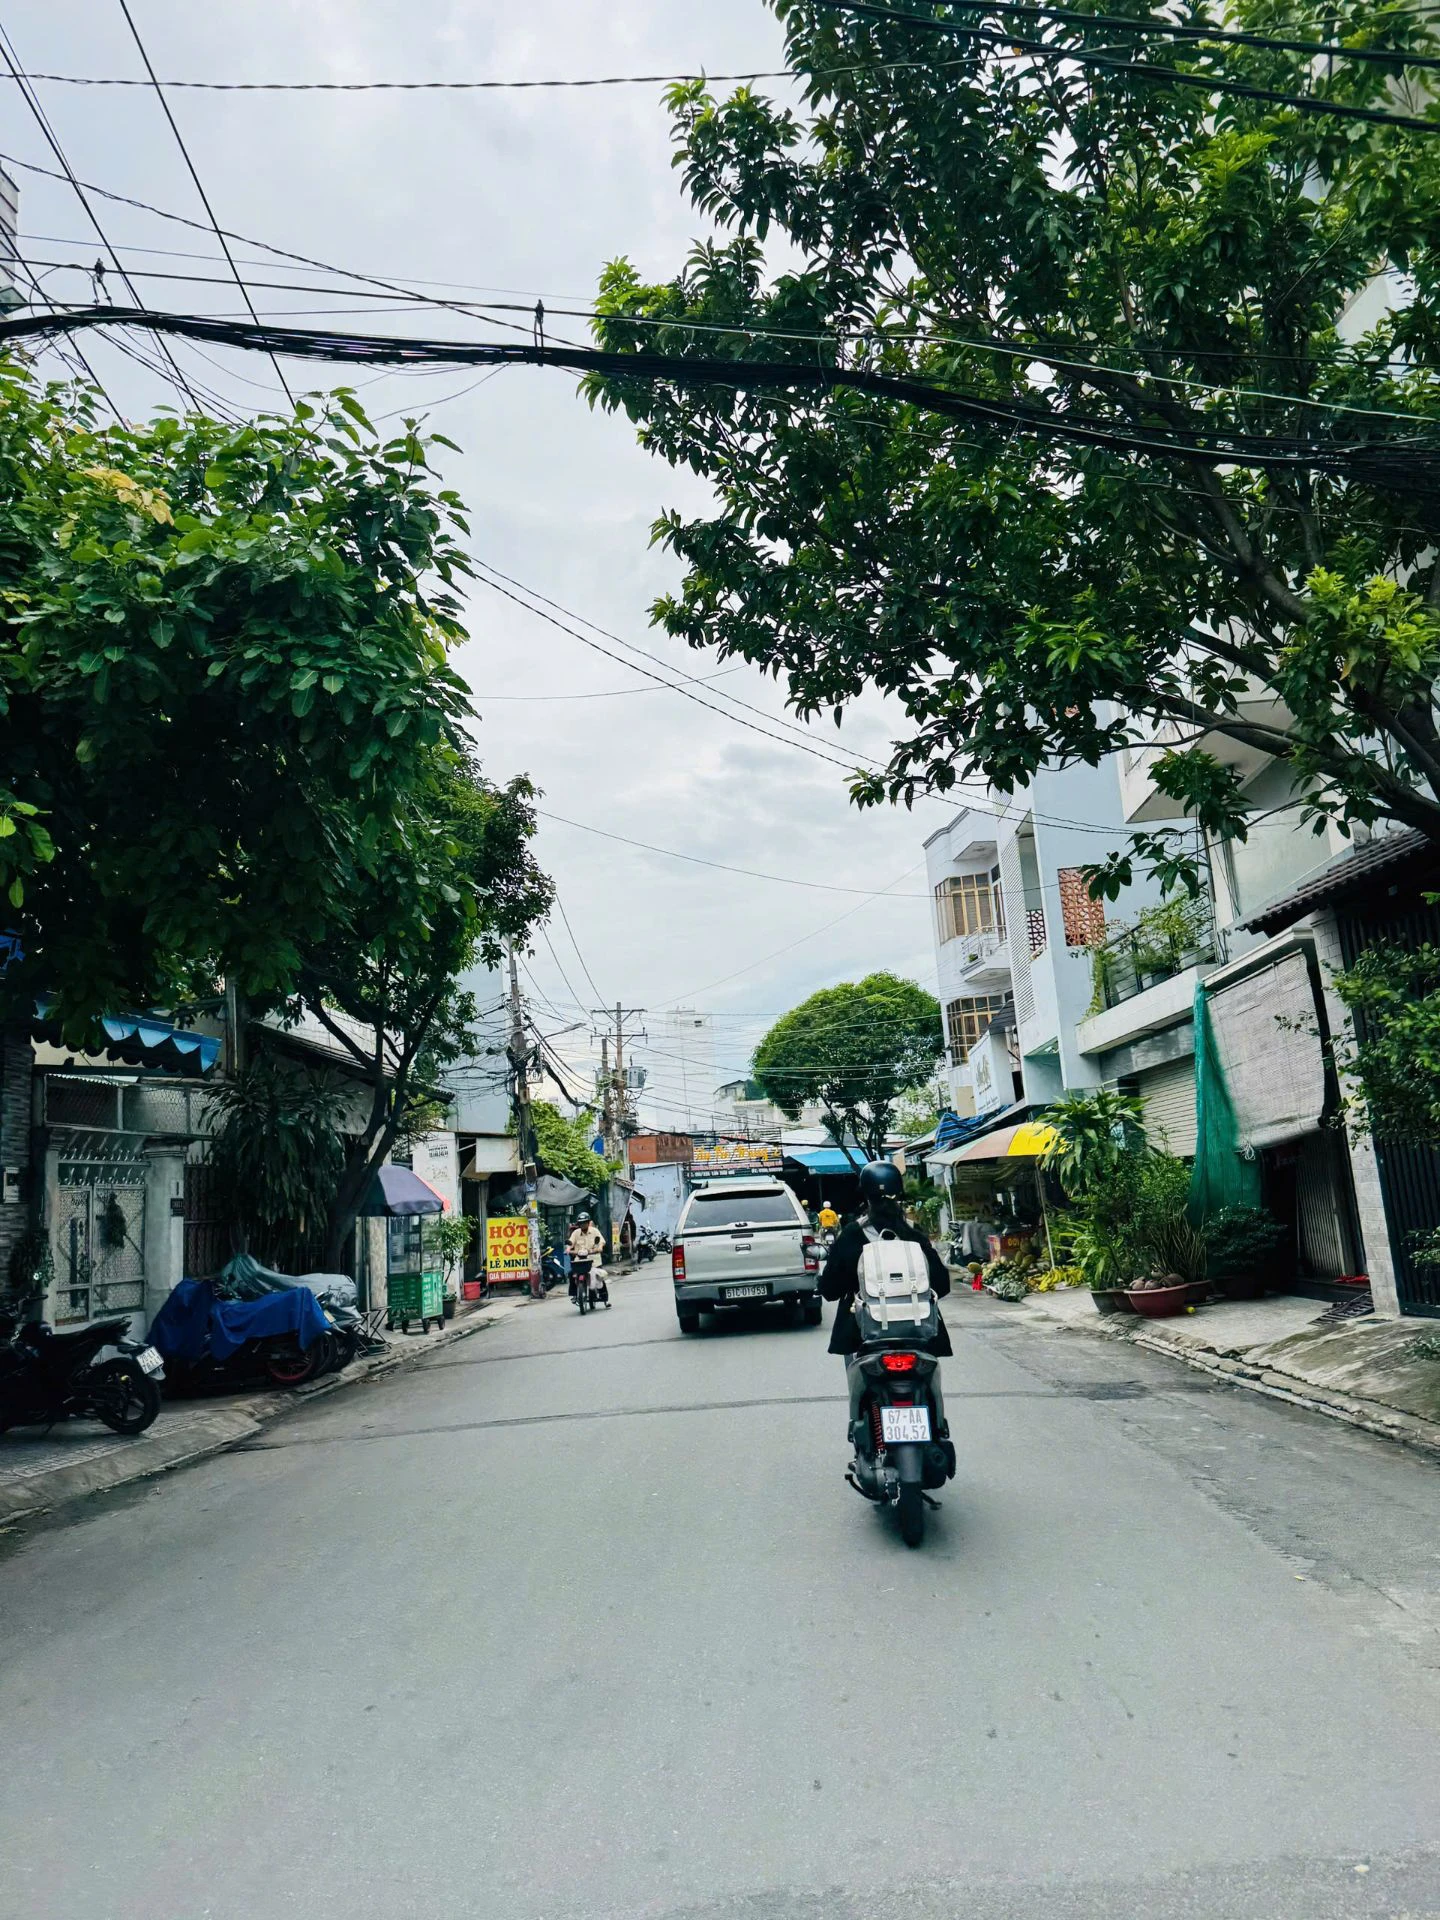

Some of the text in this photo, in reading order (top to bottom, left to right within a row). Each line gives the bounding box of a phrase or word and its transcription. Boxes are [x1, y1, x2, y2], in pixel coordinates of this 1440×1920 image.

[489, 1221, 528, 1239] HỚT
[490, 1239, 528, 1257] TÓC
[490, 1258, 529, 1269] LÊ MINH
[888, 1409, 922, 1424] 67-AA
[886, 1425, 928, 1440] 304.52
